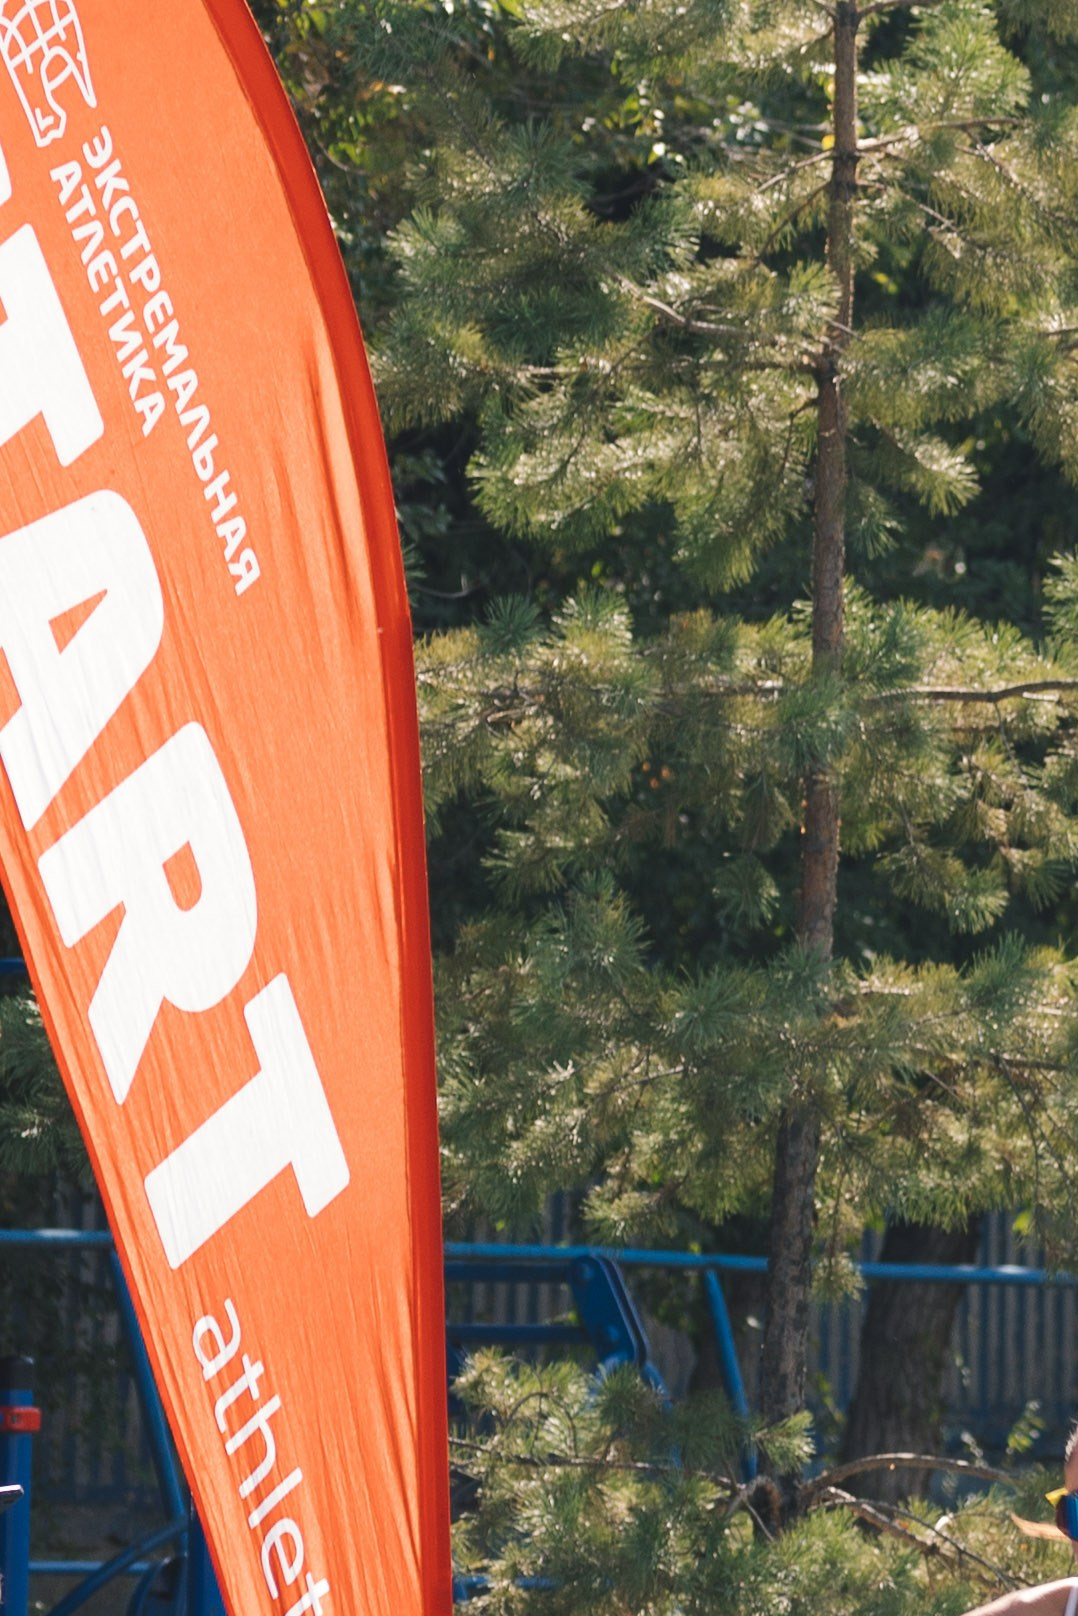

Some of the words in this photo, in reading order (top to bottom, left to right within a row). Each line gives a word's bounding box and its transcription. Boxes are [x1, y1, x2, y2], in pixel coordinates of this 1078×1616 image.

[49, 160, 166, 437] АТЛЕТИКА
[82, 125, 261, 596] ЭКСТРЕМАЛЬНАЯ
[0, 143, 350, 1270] TART
